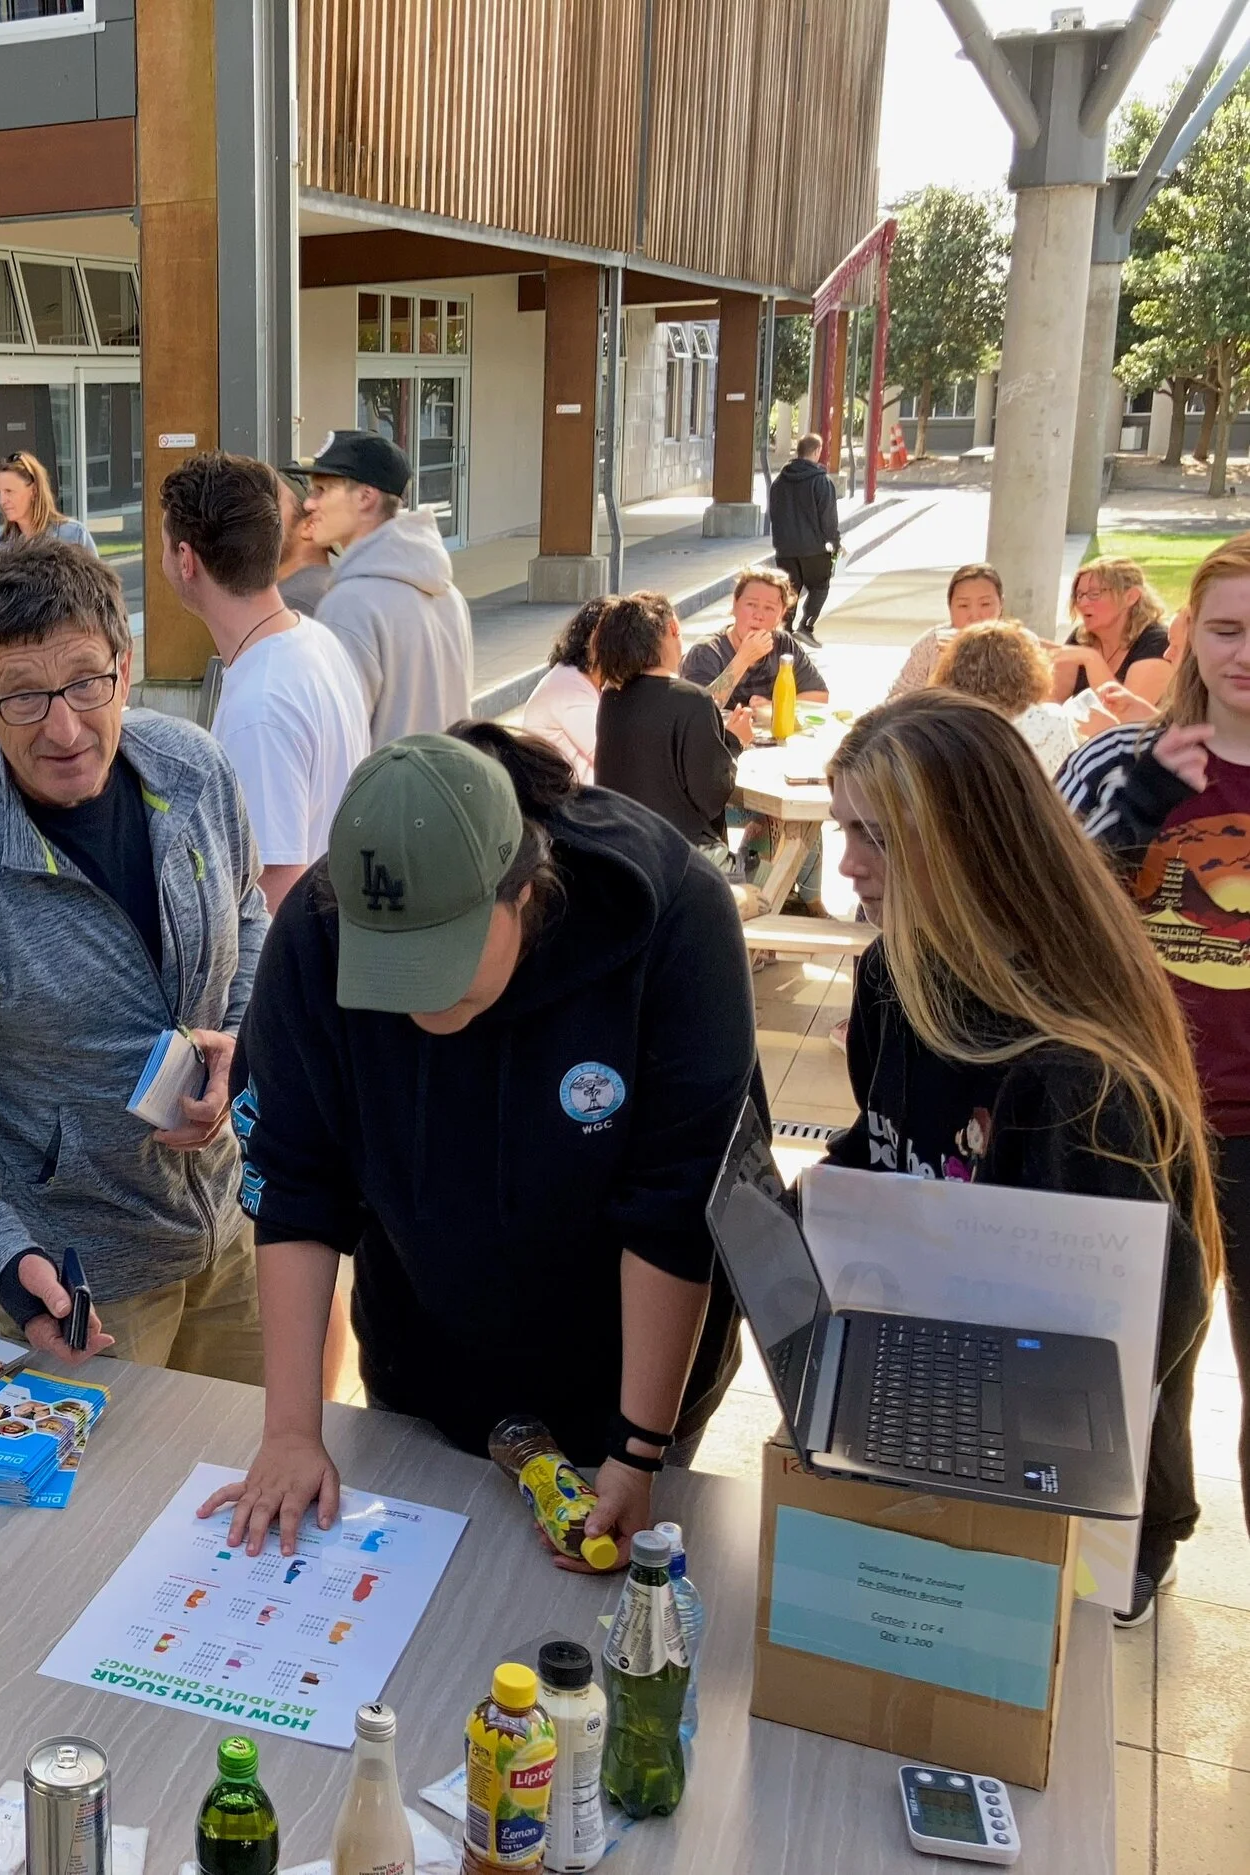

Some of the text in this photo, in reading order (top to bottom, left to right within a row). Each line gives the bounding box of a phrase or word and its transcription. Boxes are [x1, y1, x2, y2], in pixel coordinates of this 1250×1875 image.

[360, 848, 404, 912] LA
[582, 1120, 613, 1134] WGC
[858, 1561, 965, 1591] Diabetes New Zealand
[919, 1592, 963, 1608] Brochure
[920, 1623, 935, 1632] OF
[99, 1658, 318, 1717] ARE ADULTS DRINKING?
[90, 1667, 310, 1731] HOW MUCH SUGAR
[515, 1765, 554, 1786] Lipto
[501, 1827, 538, 1840] Lemon
